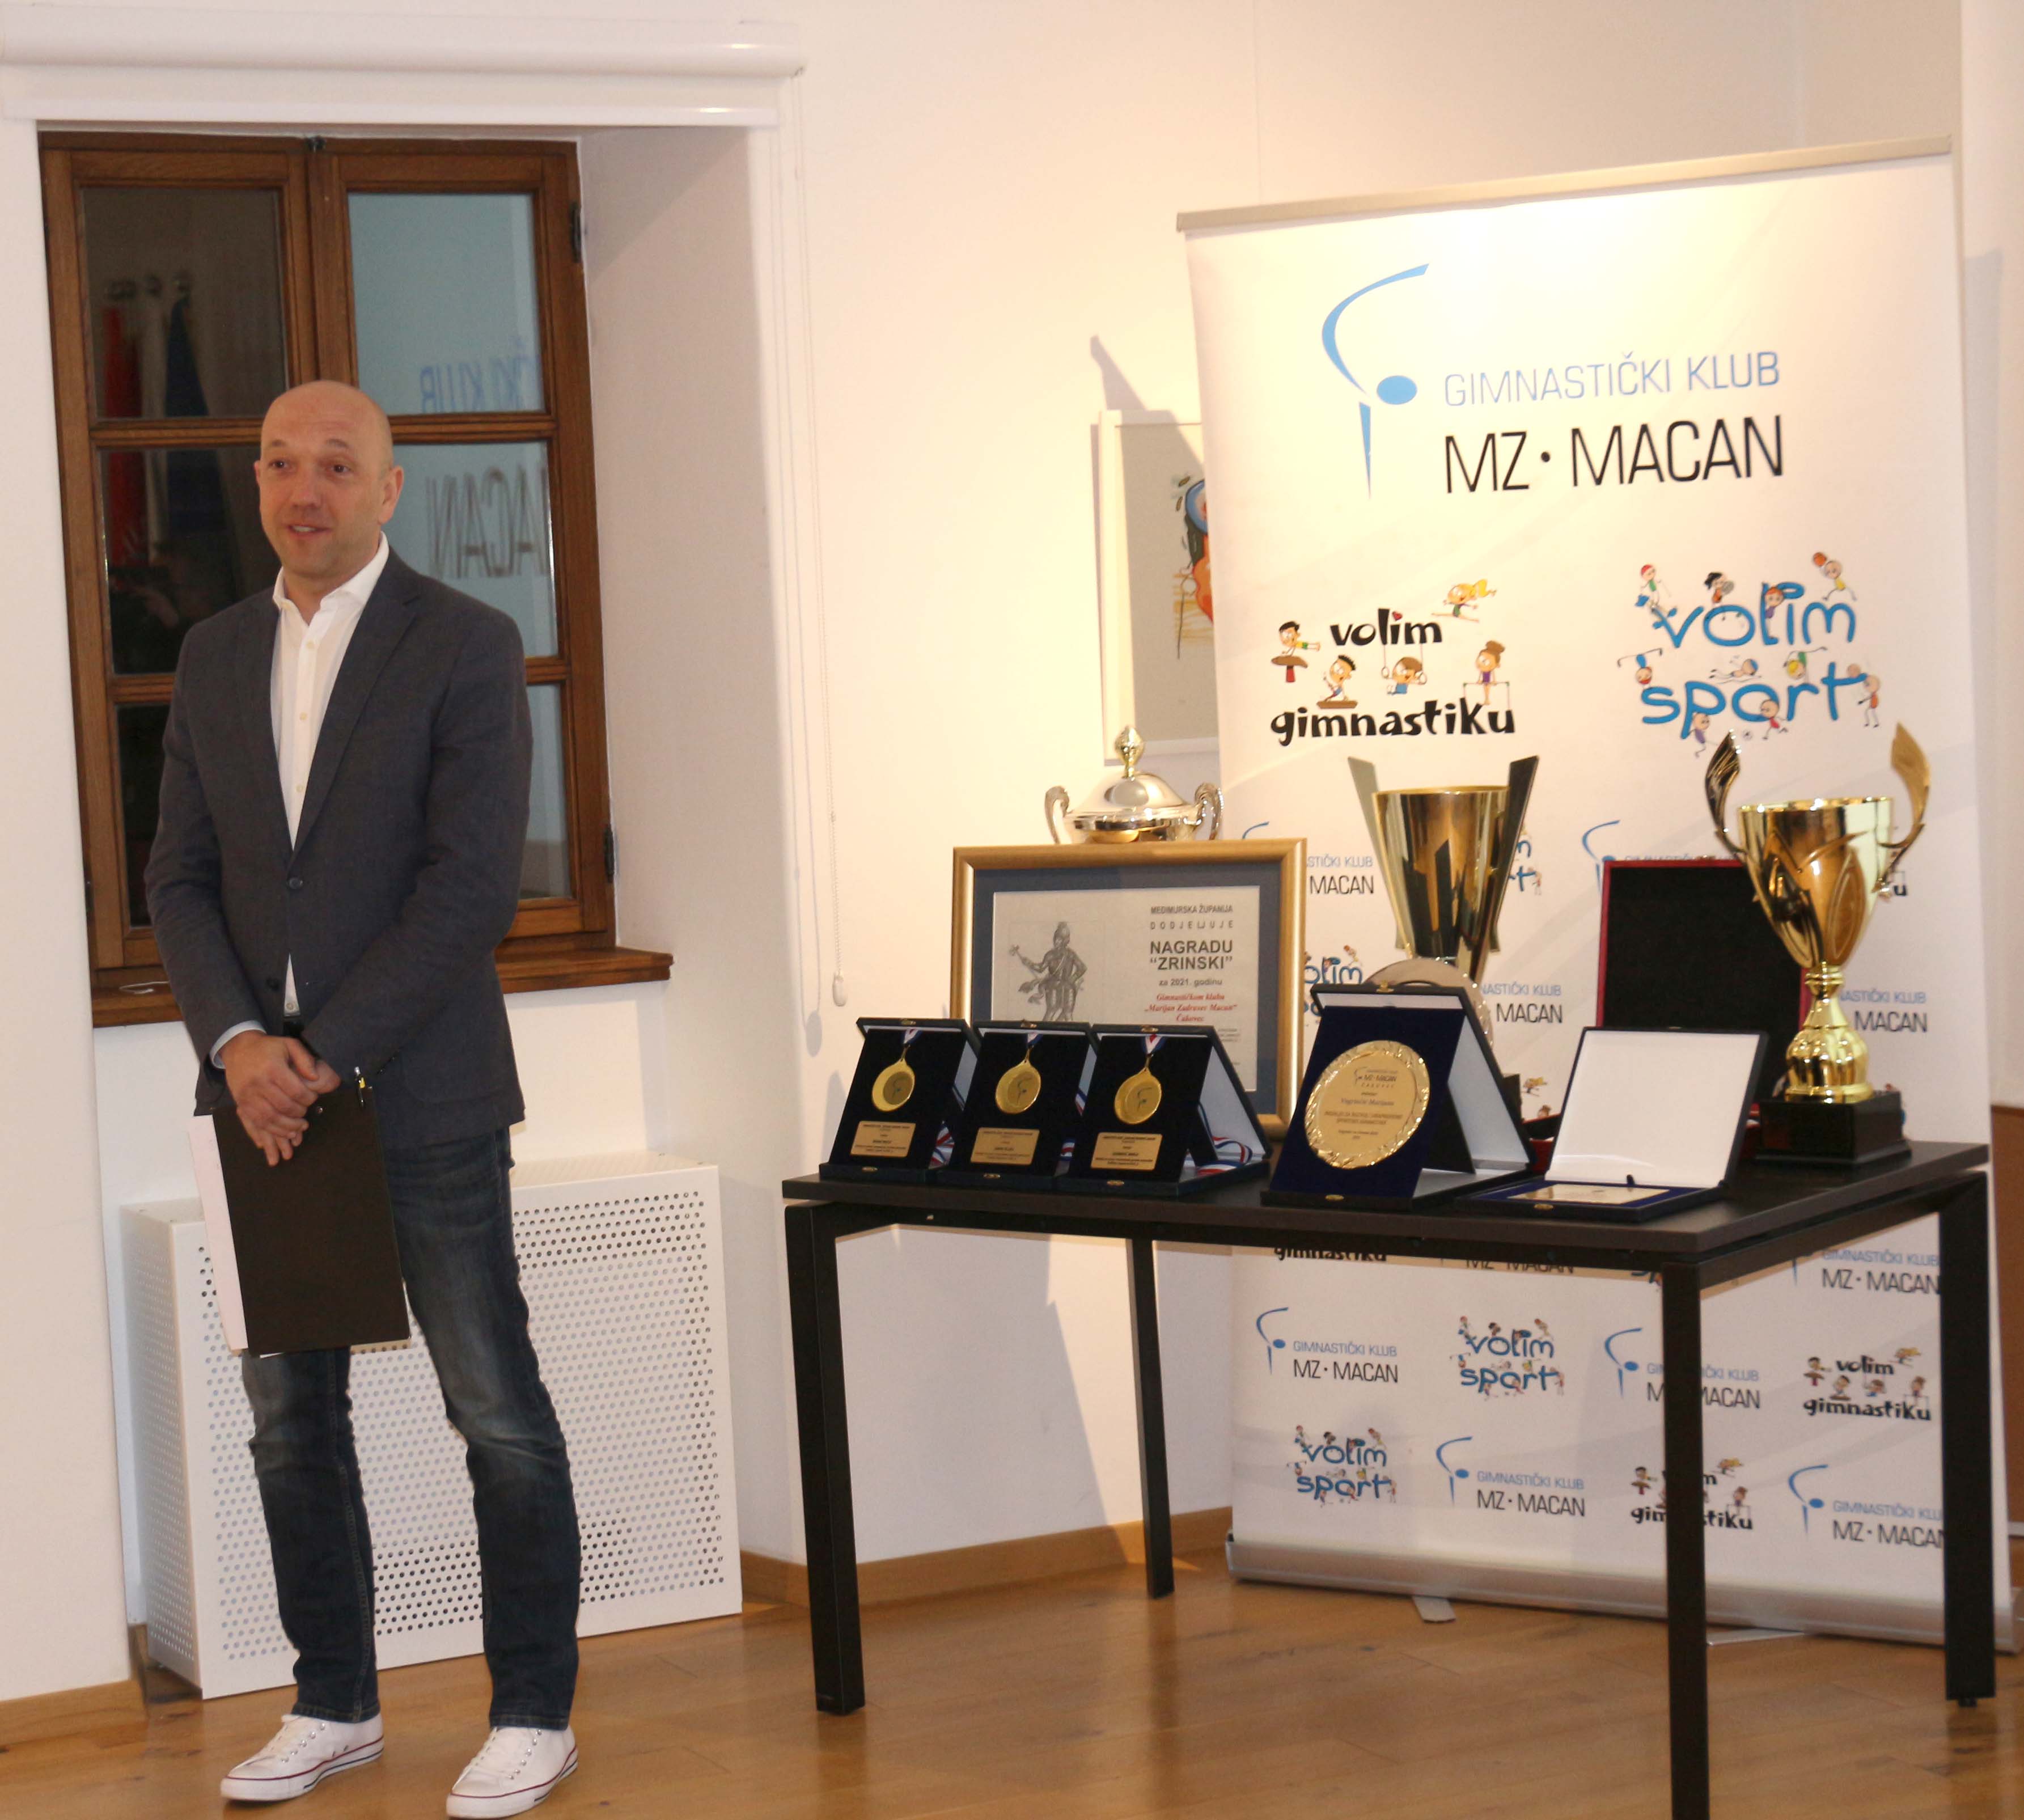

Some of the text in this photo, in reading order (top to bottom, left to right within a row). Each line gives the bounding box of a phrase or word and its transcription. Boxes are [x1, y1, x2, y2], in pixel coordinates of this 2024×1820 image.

[1445, 350, 1780, 407] GIMNASTIČKI KLUB
[1445, 414, 1784, 494] MZ MACAN
[1653, 581, 1856, 649] volim
[1329, 608, 1443, 646] volim
[1640, 661, 1868, 740] sport
[1271, 697, 1515, 746] gimnastiku
[1344, 856, 1373, 867] KLUB
[1309, 875, 1374, 895] MACAN
[1150, 939, 1233, 955] NAGRADU
[1305, 956, 1363, 984] olim
[1194, 978, 1223, 988] godinu
[1533, 984, 1561, 996] KLUB
[1894, 991, 1926, 1004] KLUB
[1496, 1002, 1563, 1023] MACAN
[1854, 1010, 1928, 1032] MACAN
[1822, 1268, 1854, 1289] MZ
[1293, 1340, 1398, 1357] GIMNASTIČKI KLUB
[1467, 1328, 1555, 1358] volim
[1293, 1358, 1399, 1383] MZ MACAN
[1836, 1355, 1894, 1375] volim
[1460, 1365, 1559, 1394] sport
[1803, 1397, 1932, 1421] gimnastiku
[1302, 1437, 1388, 1467] volim
[1296, 1474, 1392, 1501] sport
[1476, 1470, 1585, 1491] GIMNASTIČKI KLUB
[1476, 1489, 1586, 1517] MZ MACAN
[1918, 1508, 1942, 1521] KLU
[1832, 1520, 1864, 1542] MZ
